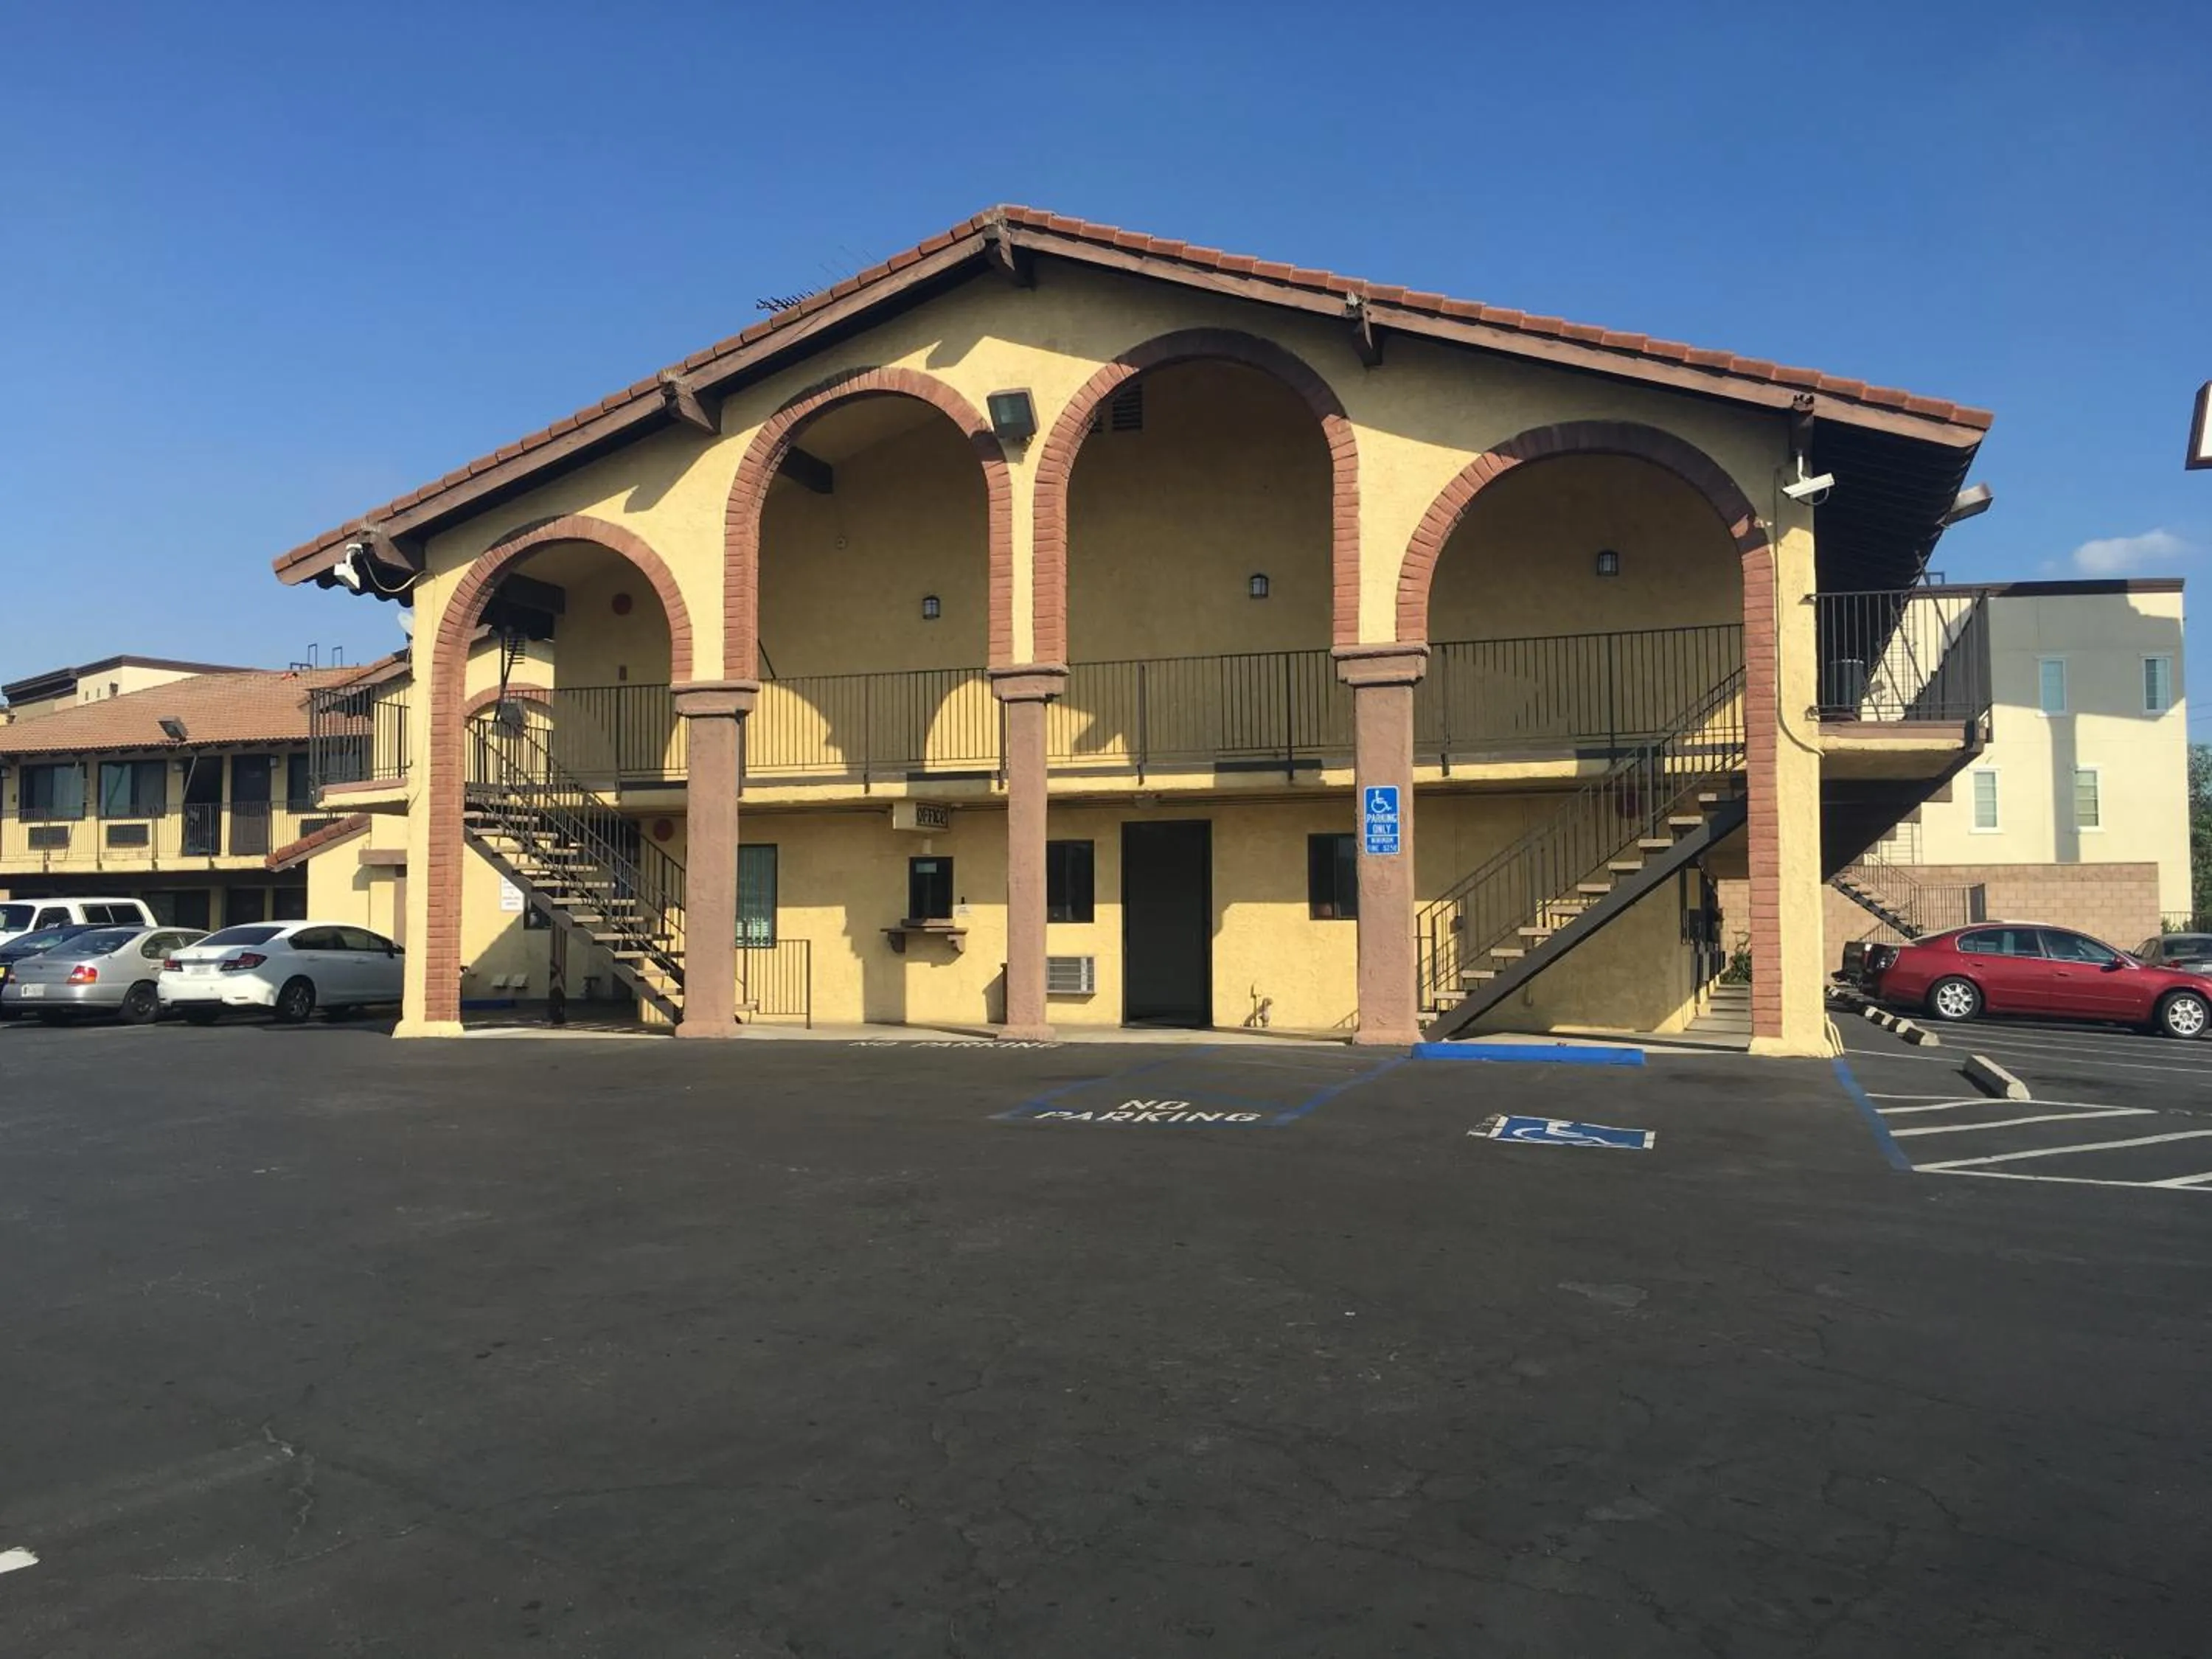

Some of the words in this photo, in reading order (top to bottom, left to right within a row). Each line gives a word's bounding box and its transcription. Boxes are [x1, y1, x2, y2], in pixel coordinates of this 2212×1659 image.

[917, 807, 946, 824] OFFICE
[1366, 814, 1397, 823] PARKING
[1372, 824, 1392, 834] ONLY
[1118, 1099, 1191, 1110] NO
[1034, 1111, 1262, 1122] PARKING
